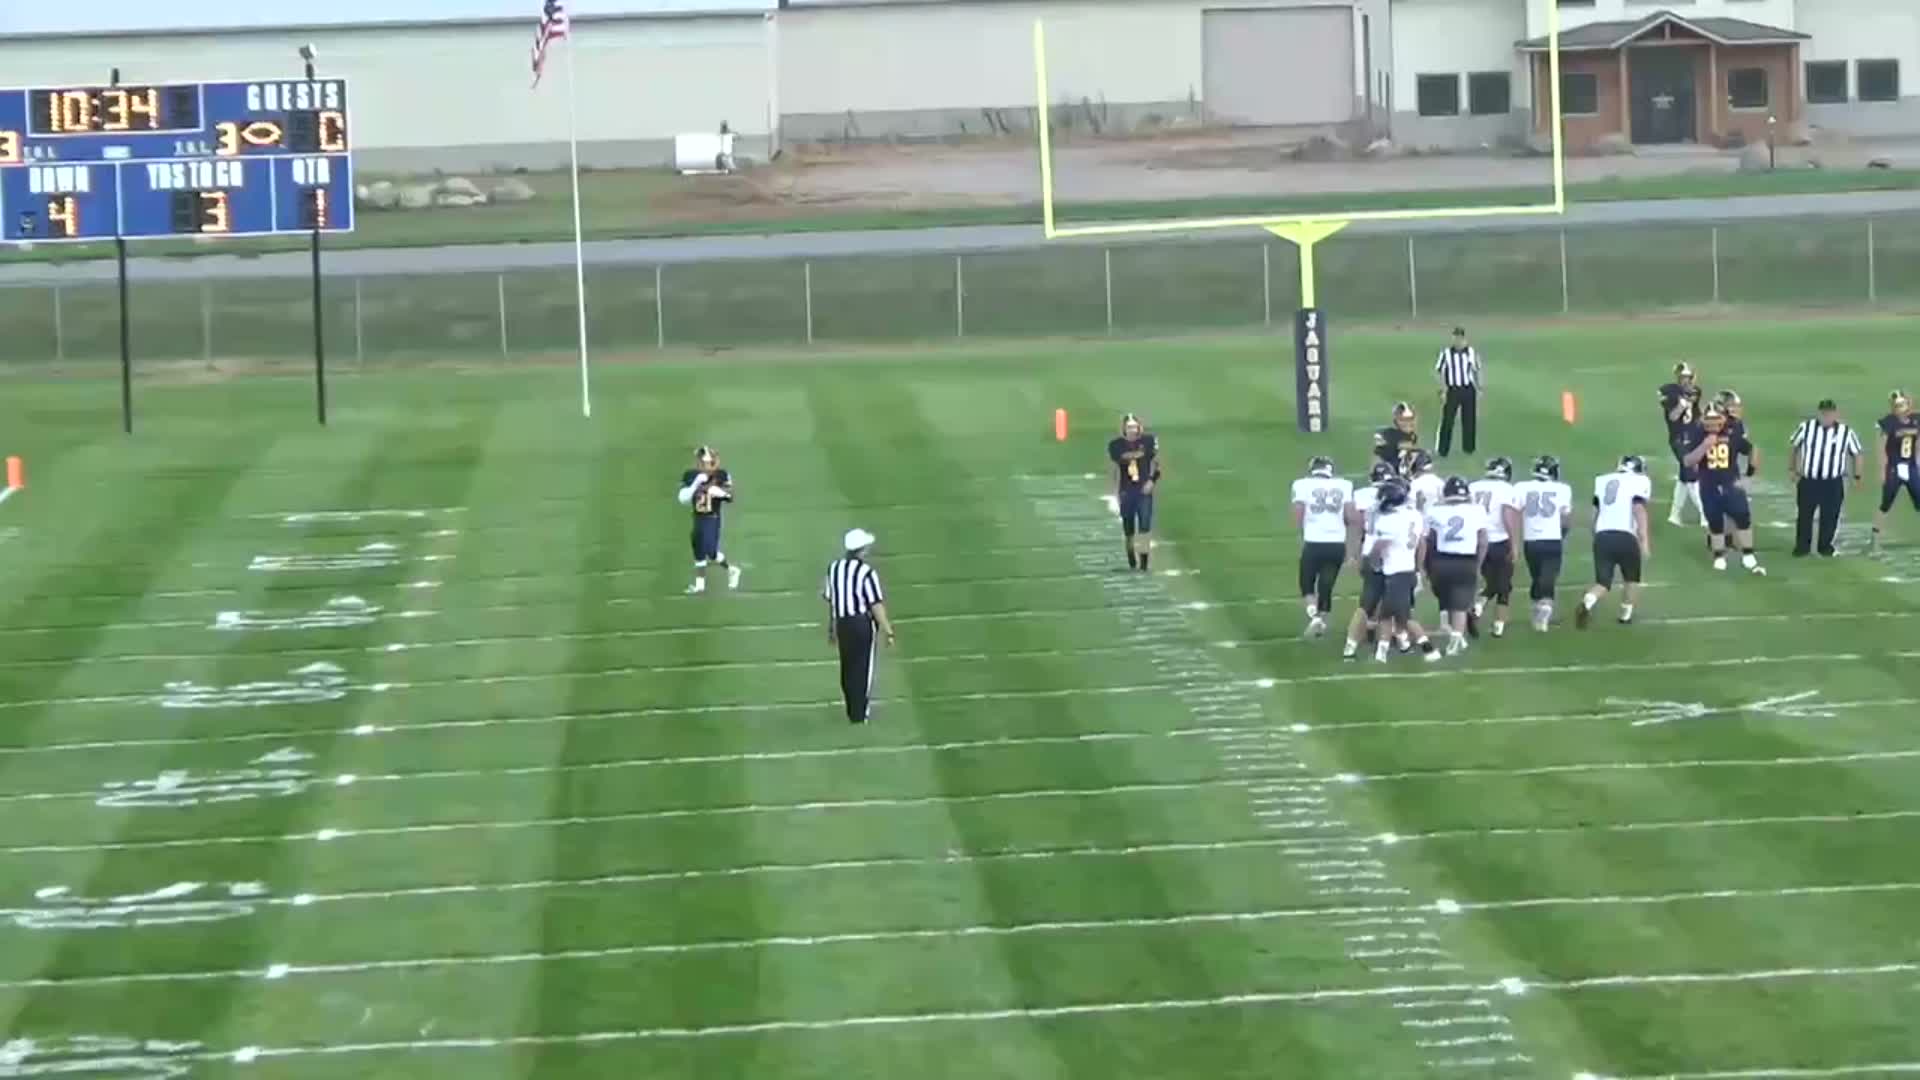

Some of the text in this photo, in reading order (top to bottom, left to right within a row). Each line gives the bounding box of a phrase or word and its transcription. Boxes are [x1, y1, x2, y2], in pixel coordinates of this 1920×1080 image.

[50, 88, 159, 132] 10:34
[247, 82, 339, 111] GUESTS
[215, 121, 239, 155] 3
[29, 166, 90, 193] DOWN
[188, 161, 213, 188] TO
[292, 158, 331, 185] QTR
[48, 196, 76, 237] 4
[200, 191, 230, 232] 3
[314, 188, 327, 228] 1
[1706, 443, 1730, 469] 99
[1310, 488, 1344, 514] 33
[1525, 491, 1557, 518] 85
[1444, 516, 1465, 542] 2
